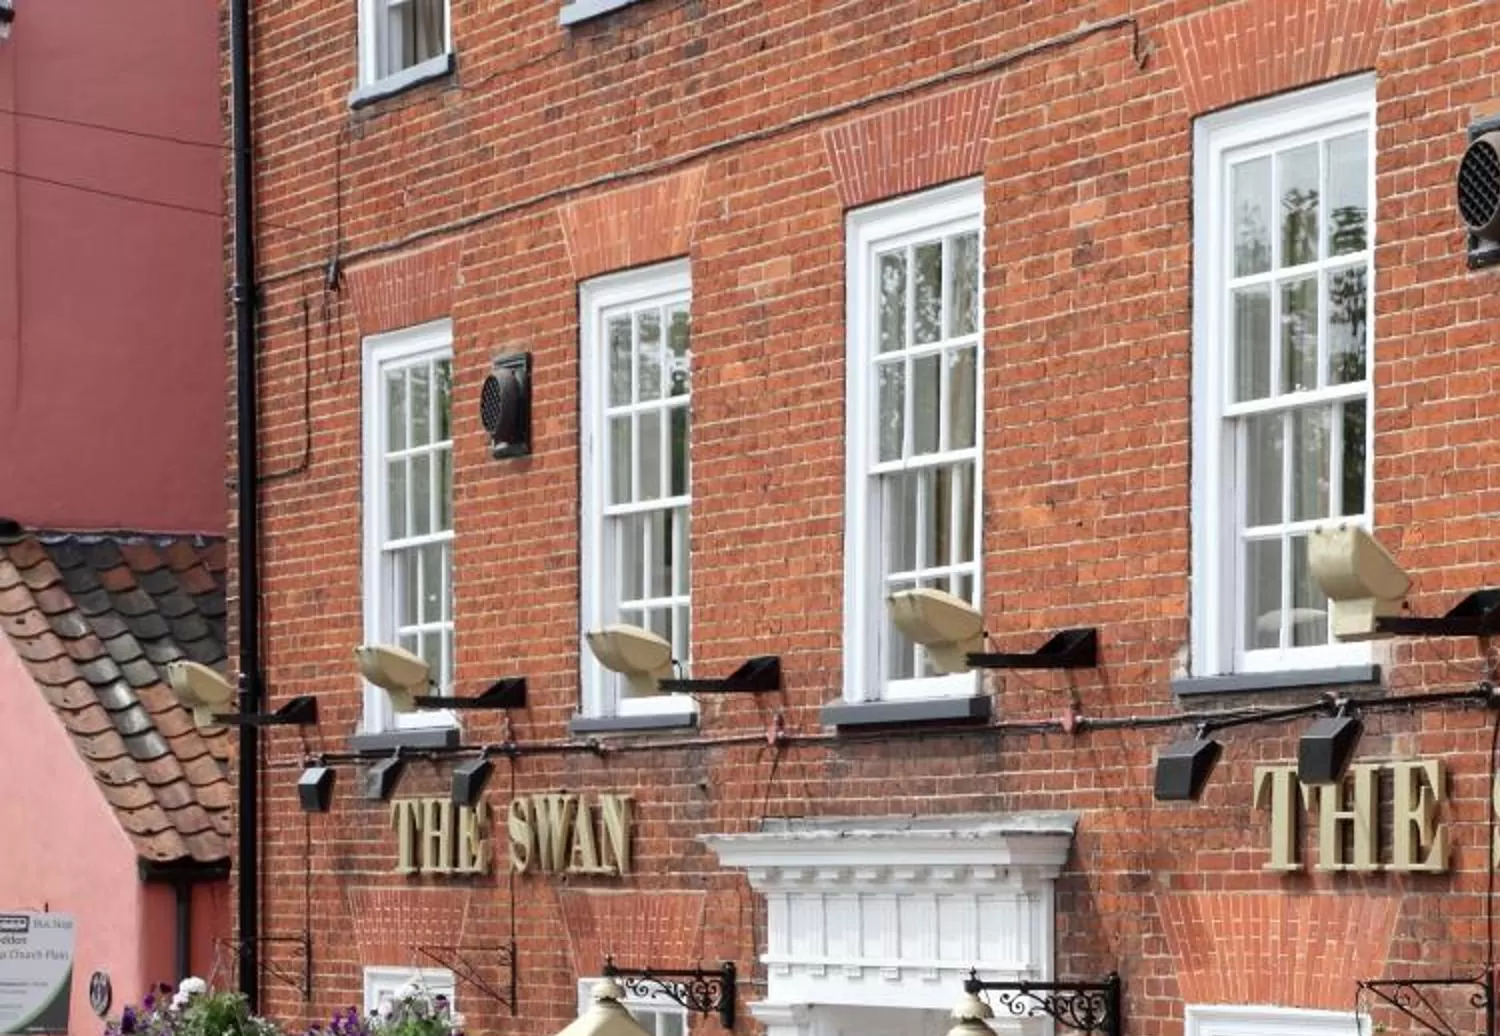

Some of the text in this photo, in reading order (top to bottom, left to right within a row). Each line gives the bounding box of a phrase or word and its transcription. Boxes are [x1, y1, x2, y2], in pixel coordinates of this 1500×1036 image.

[390, 793, 634, 877] THE SWAN
[1253, 758, 1450, 873] THE
